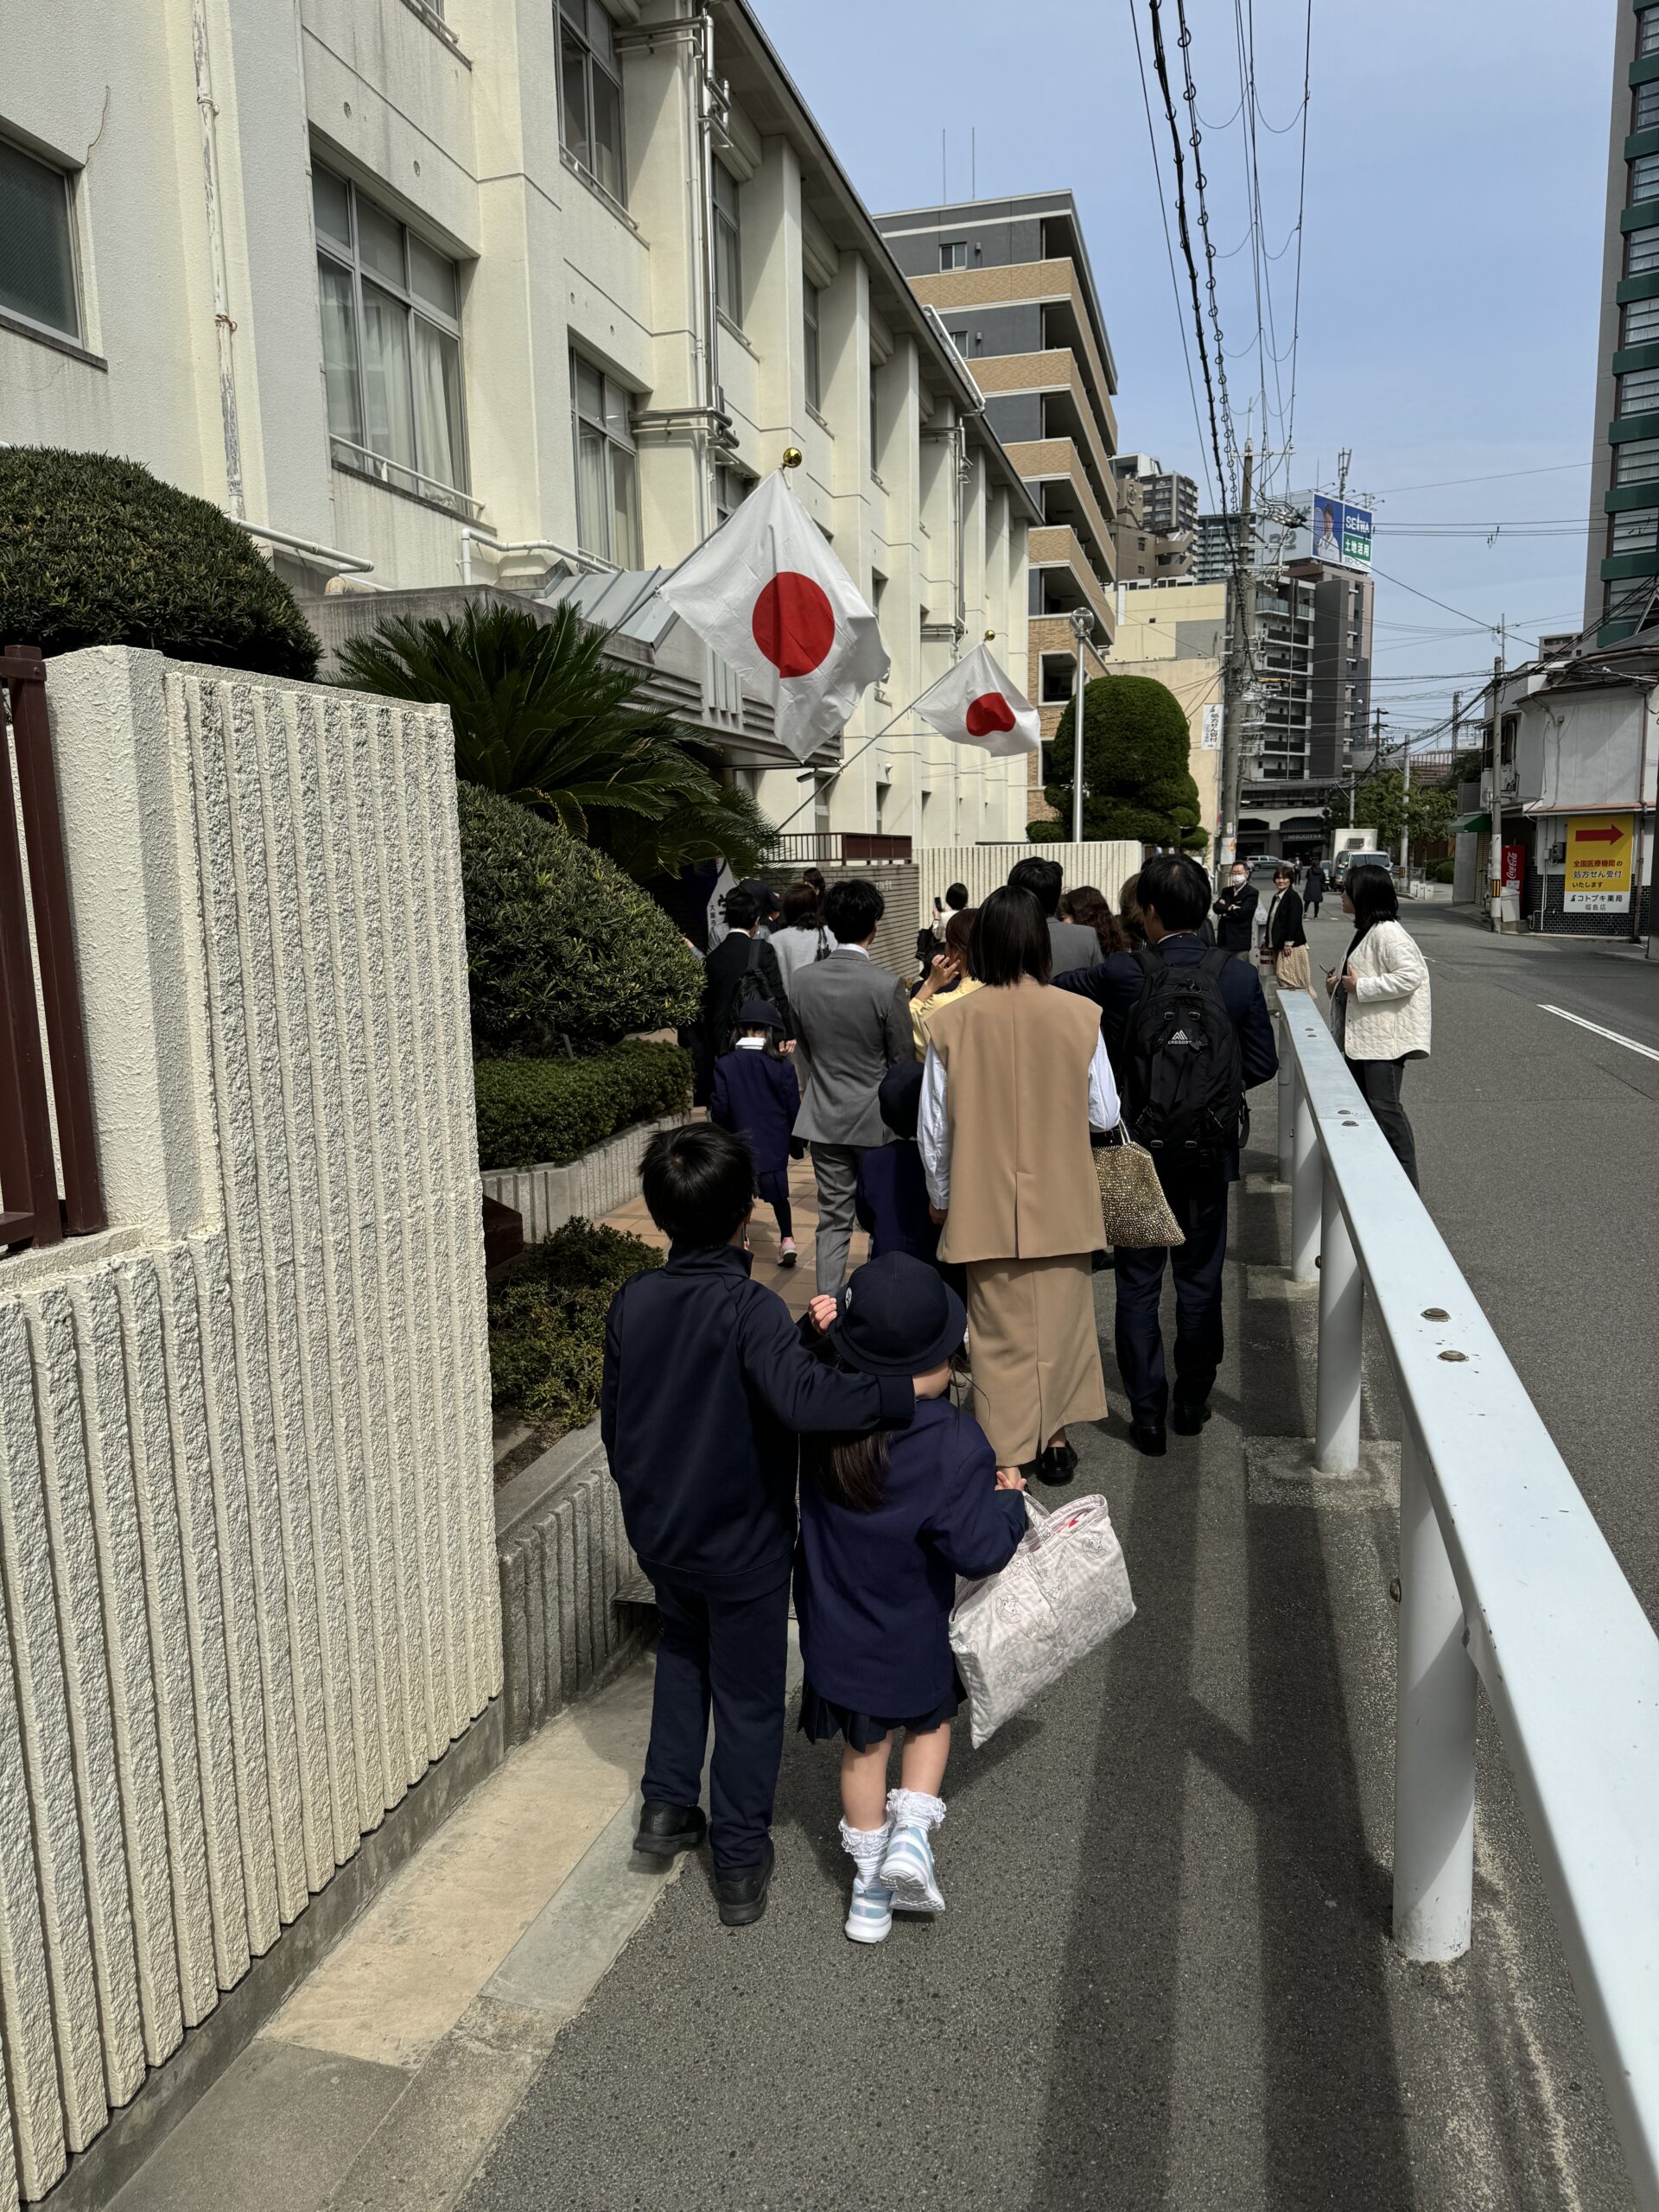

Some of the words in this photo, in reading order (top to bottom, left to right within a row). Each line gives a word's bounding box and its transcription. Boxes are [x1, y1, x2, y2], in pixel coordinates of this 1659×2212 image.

[1346, 513, 1369, 532] SEIWA
[1345, 539, 1369, 556] 土地活用
